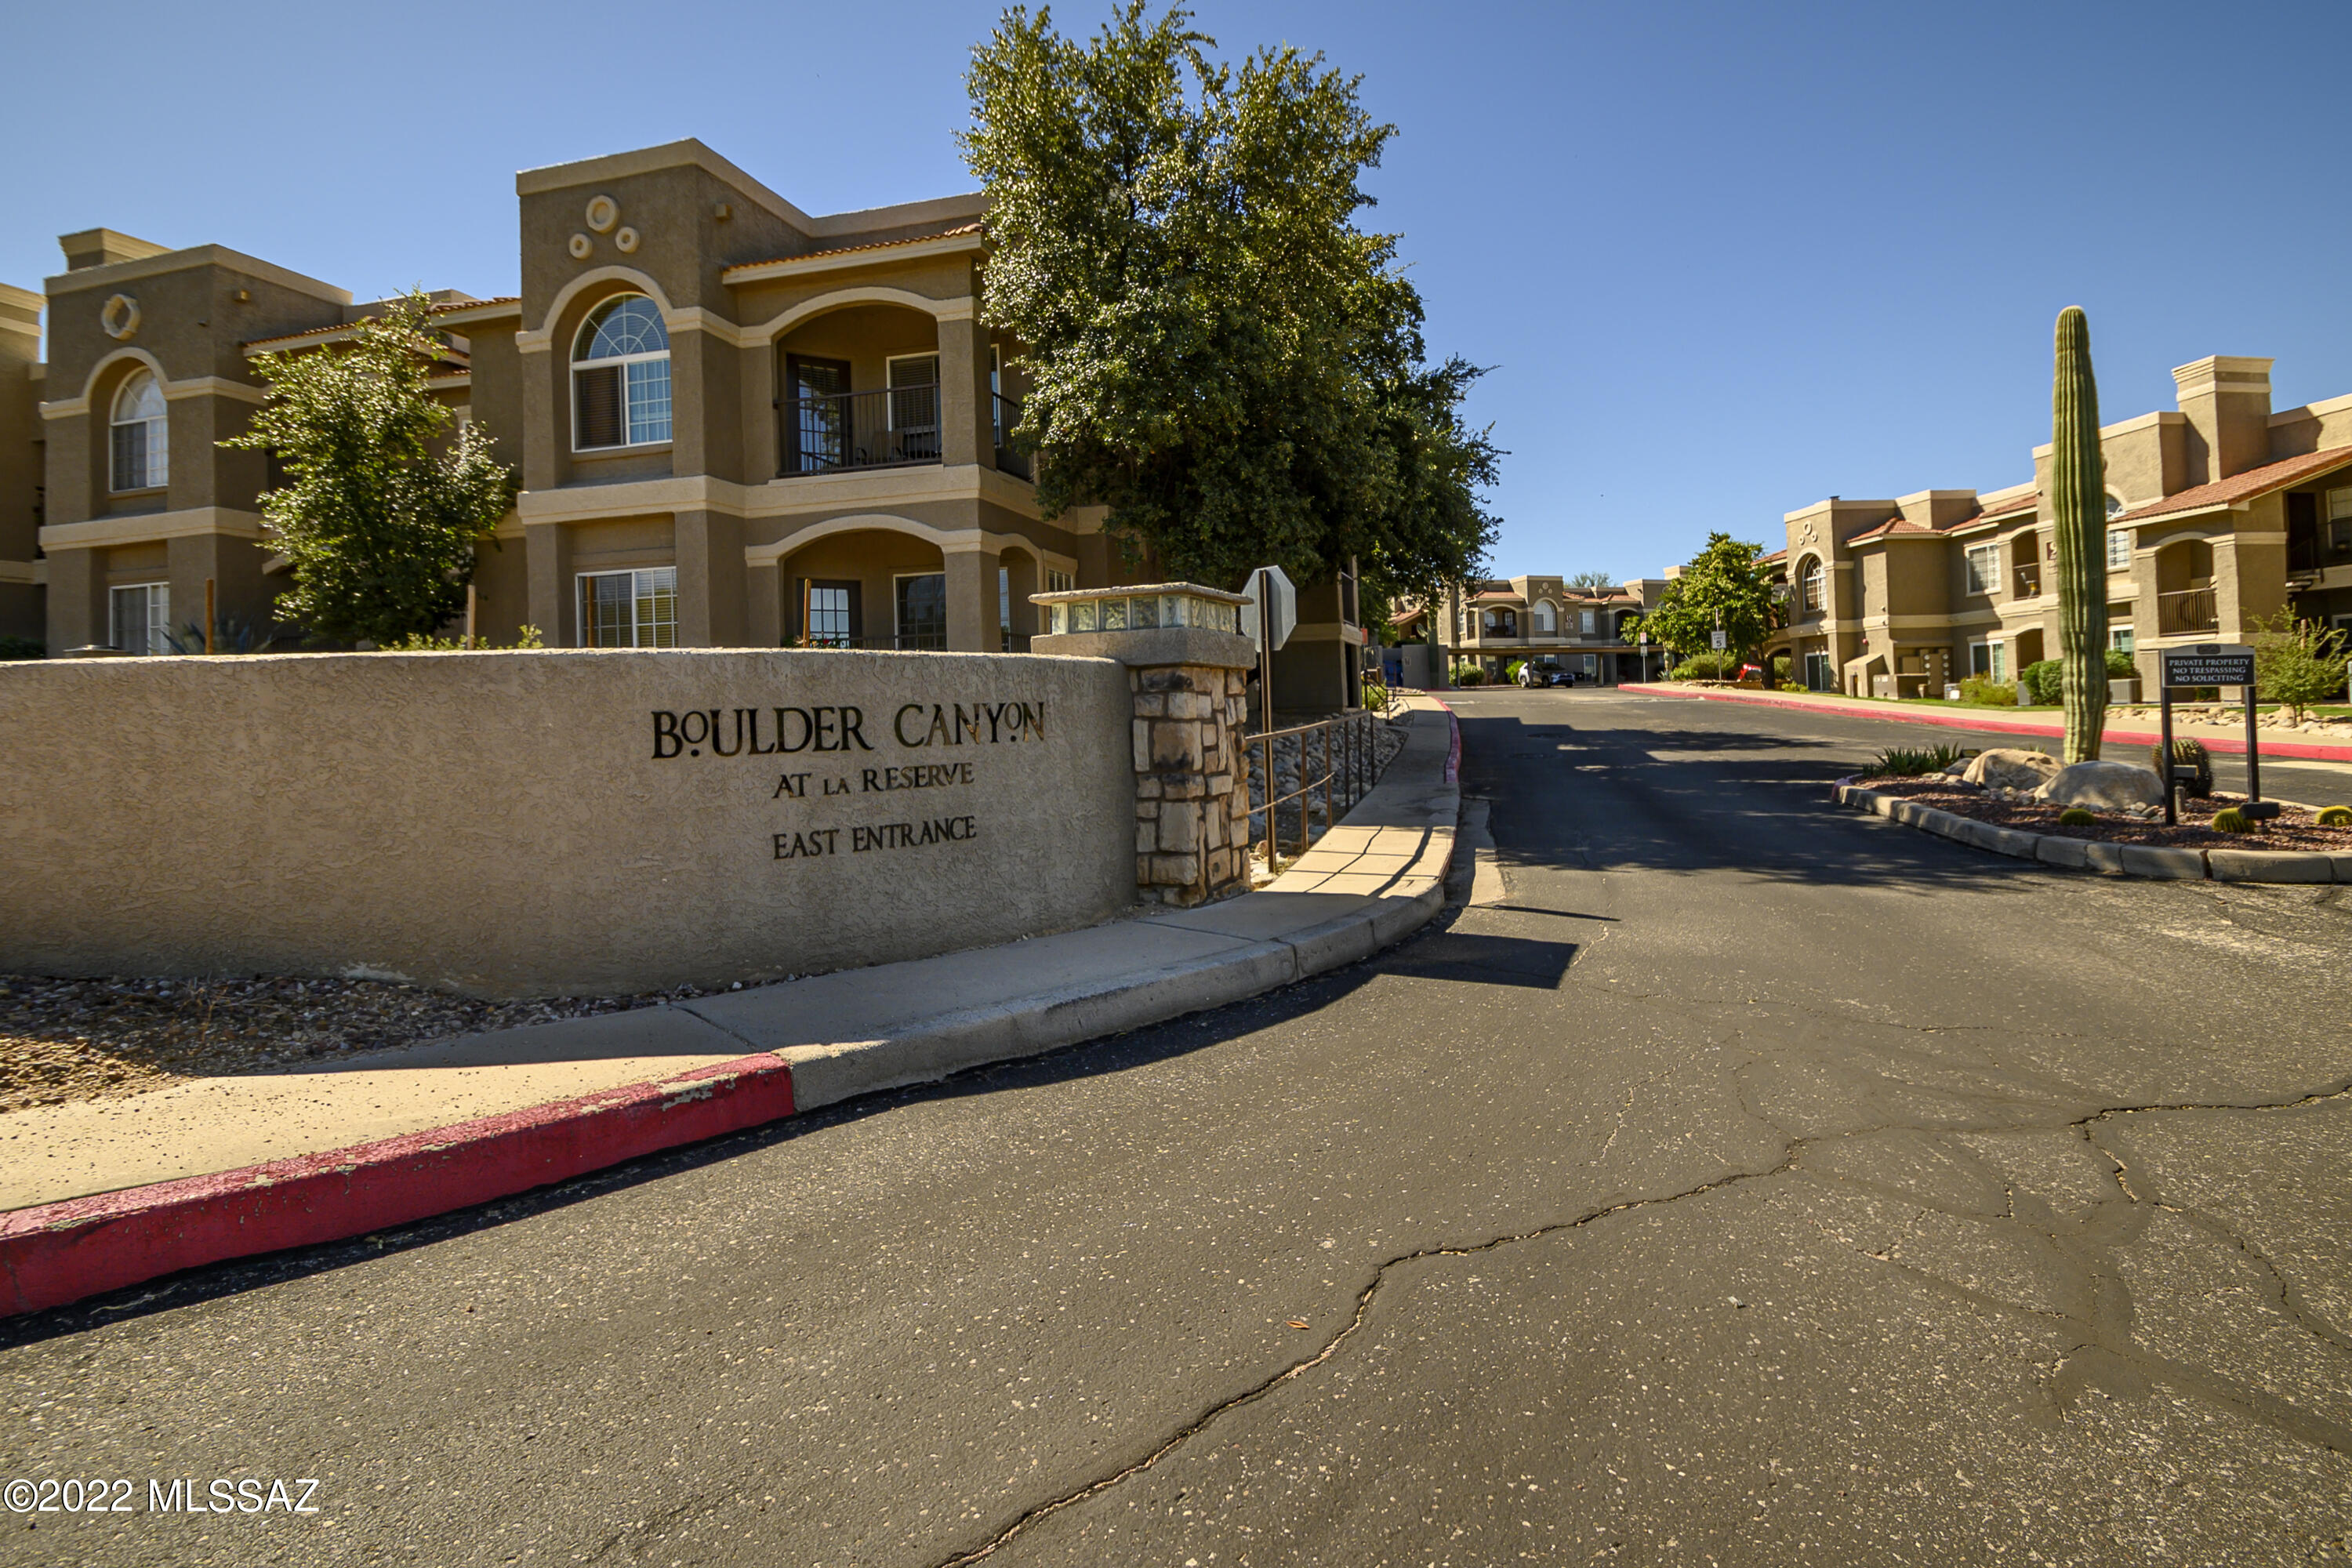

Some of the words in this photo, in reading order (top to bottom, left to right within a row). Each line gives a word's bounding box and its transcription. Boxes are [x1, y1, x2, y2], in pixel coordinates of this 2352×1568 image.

[651, 706, 874, 759] BOULDER
[894, 702, 1046, 748] CANYON
[772, 773, 811, 799] AT
[822, 778, 851, 795] LA
[862, 762, 975, 792] RESERVE
[773, 829, 840, 860] EAST
[852, 815, 977, 852] ENTRANCE
